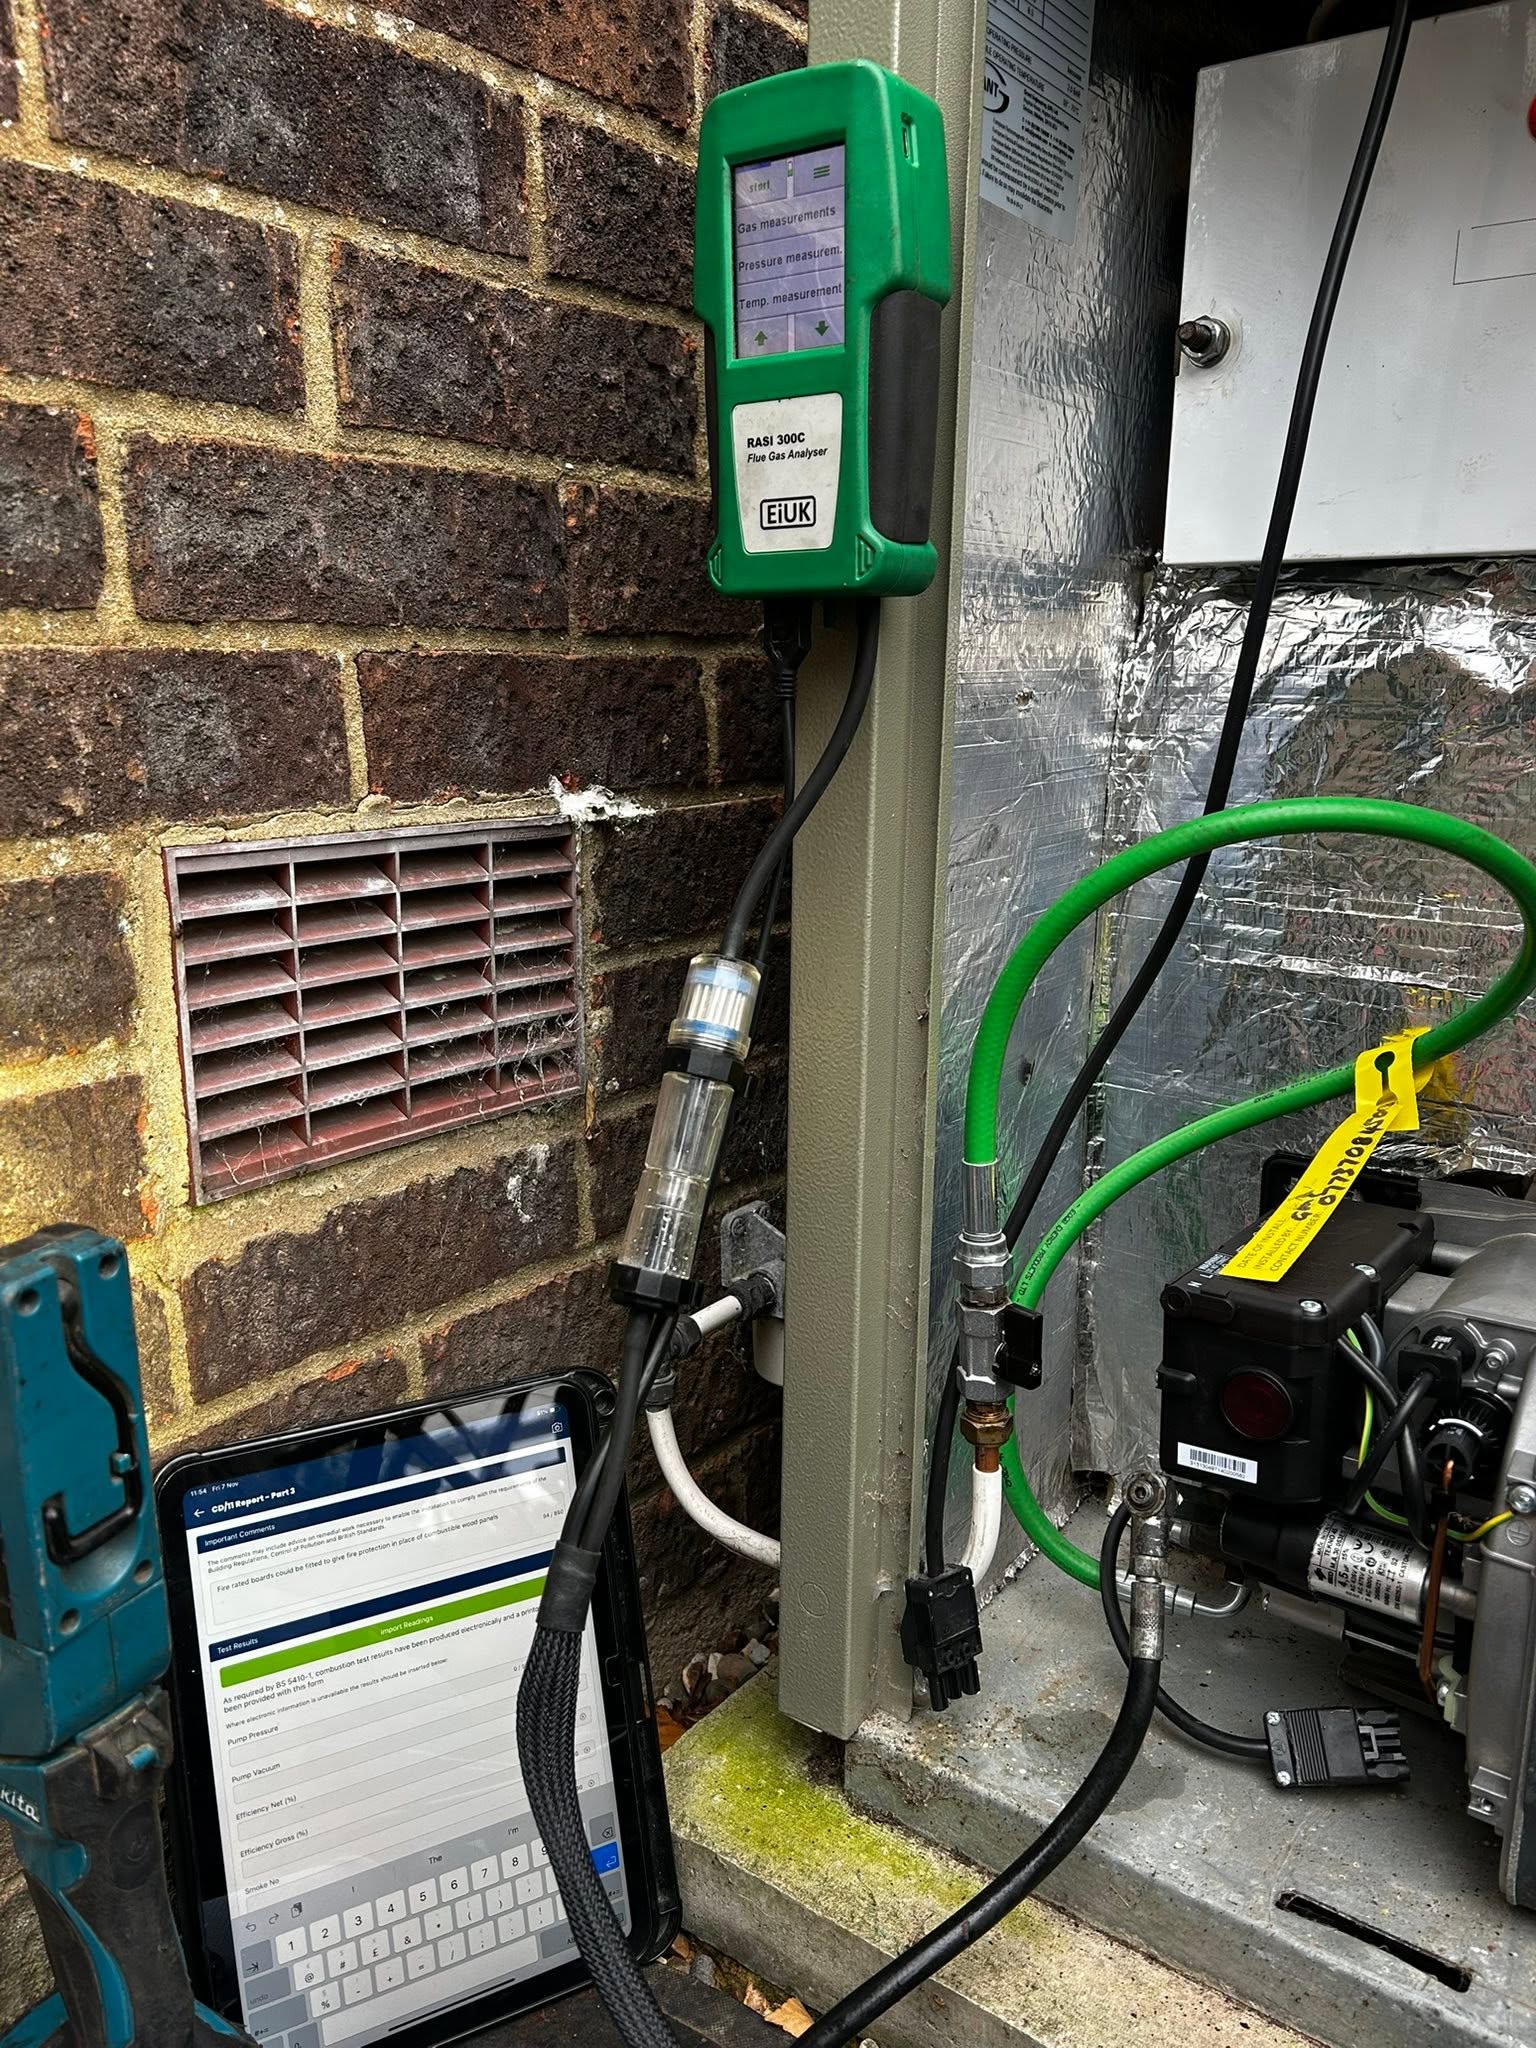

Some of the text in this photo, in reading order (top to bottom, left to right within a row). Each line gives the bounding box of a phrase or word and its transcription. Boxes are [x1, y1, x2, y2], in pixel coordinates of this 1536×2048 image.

[737, 206, 836, 234] Gas measurements
[738, 245, 843, 272] Pressure measurem.
[740, 283, 842, 310] Temp. measurement
[747, 432, 806, 448] RASI 300C
[747, 448, 828, 463] Flue Gas Analyser
[767, 501, 811, 524] EiUK
[191, 1488, 207, 1496] 11:54
[212, 1501, 234, 1513] CD/11
[235, 1495, 264, 1508] Report
[271, 1489, 289, 1499] Part
[205, 1525, 275, 1546] Important Comments
[220, 1552, 251, 1563] comments
[266, 1543, 286, 1551] include
[288, 1538, 307, 1546] advice
[316, 1528, 340, 1538] remedial
[356, 1519, 384, 1528] necessary
[392, 1512, 410, 1520] enable
[457, 1495, 476, 1503] comply
[208, 1564, 232, 1574] Building
[270, 1547, 292, 1557] Control
[300, 1540, 325, 1550] Pollution
[338, 1532, 356, 1540] British
[232, 1579, 249, 1588] rated
[251, 1573, 274, 1583] boards
[275, 1567, 294, 1577] could
[305, 1560, 322, 1568] fitted
[332, 1555, 345, 1563] give
[359, 1543, 390, 1556] protection
[399, 1537, 415, 1546] place
[462, 1519, 478, 1528] wood
[479, 1515, 499, 1525] panels
[381, 1616, 433, 1635] Import Readings
[218, 1638, 258, 1654] Test Results
[234, 1687, 264, 1701] required
[276, 1680, 286, 1689] BS
[315, 1661, 355, 1677] combustion
[357, 1656, 369, 1664] test
[371, 1650, 393, 1660] results
[411, 1640, 428, 1648] been
[429, 1629, 460, 1644] produced
[461, 1618, 502, 1634] electronically
[503, 1613, 515, 1621] and
[224, 1679, 324, 1713] been provided with this form
[226, 1720, 245, 1729] Where
[247, 1710, 276, 1723] electronic
[277, 1700, 310, 1713] information
[317, 1688, 349, 1701] unavailable
[361, 1679, 379, 1687] results
[380, 1672, 399, 1682] should
[408, 1662, 430, 1673] inserted
[228, 1726, 278, 1746] Pump Pressure
[232, 1763, 280, 1783] Pump Vacuum
[0, 1789, 40, 1823] kita
[236, 1795, 296, 1820] Efficiency Net (%)
[240, 1829, 308, 1858] Efficiency Gross (%)
[429, 1827, 519, 1864] The I'm
[245, 1883, 268, 1895] Smoke
[288, 1846, 548, 1951] 1 2 3 4 5 6 7 8 9
[305, 1973, 314, 1983] @
[372, 1948, 378, 1957] £
[404, 1936, 411, 1945] &
[321, 2000, 330, 2010] %
